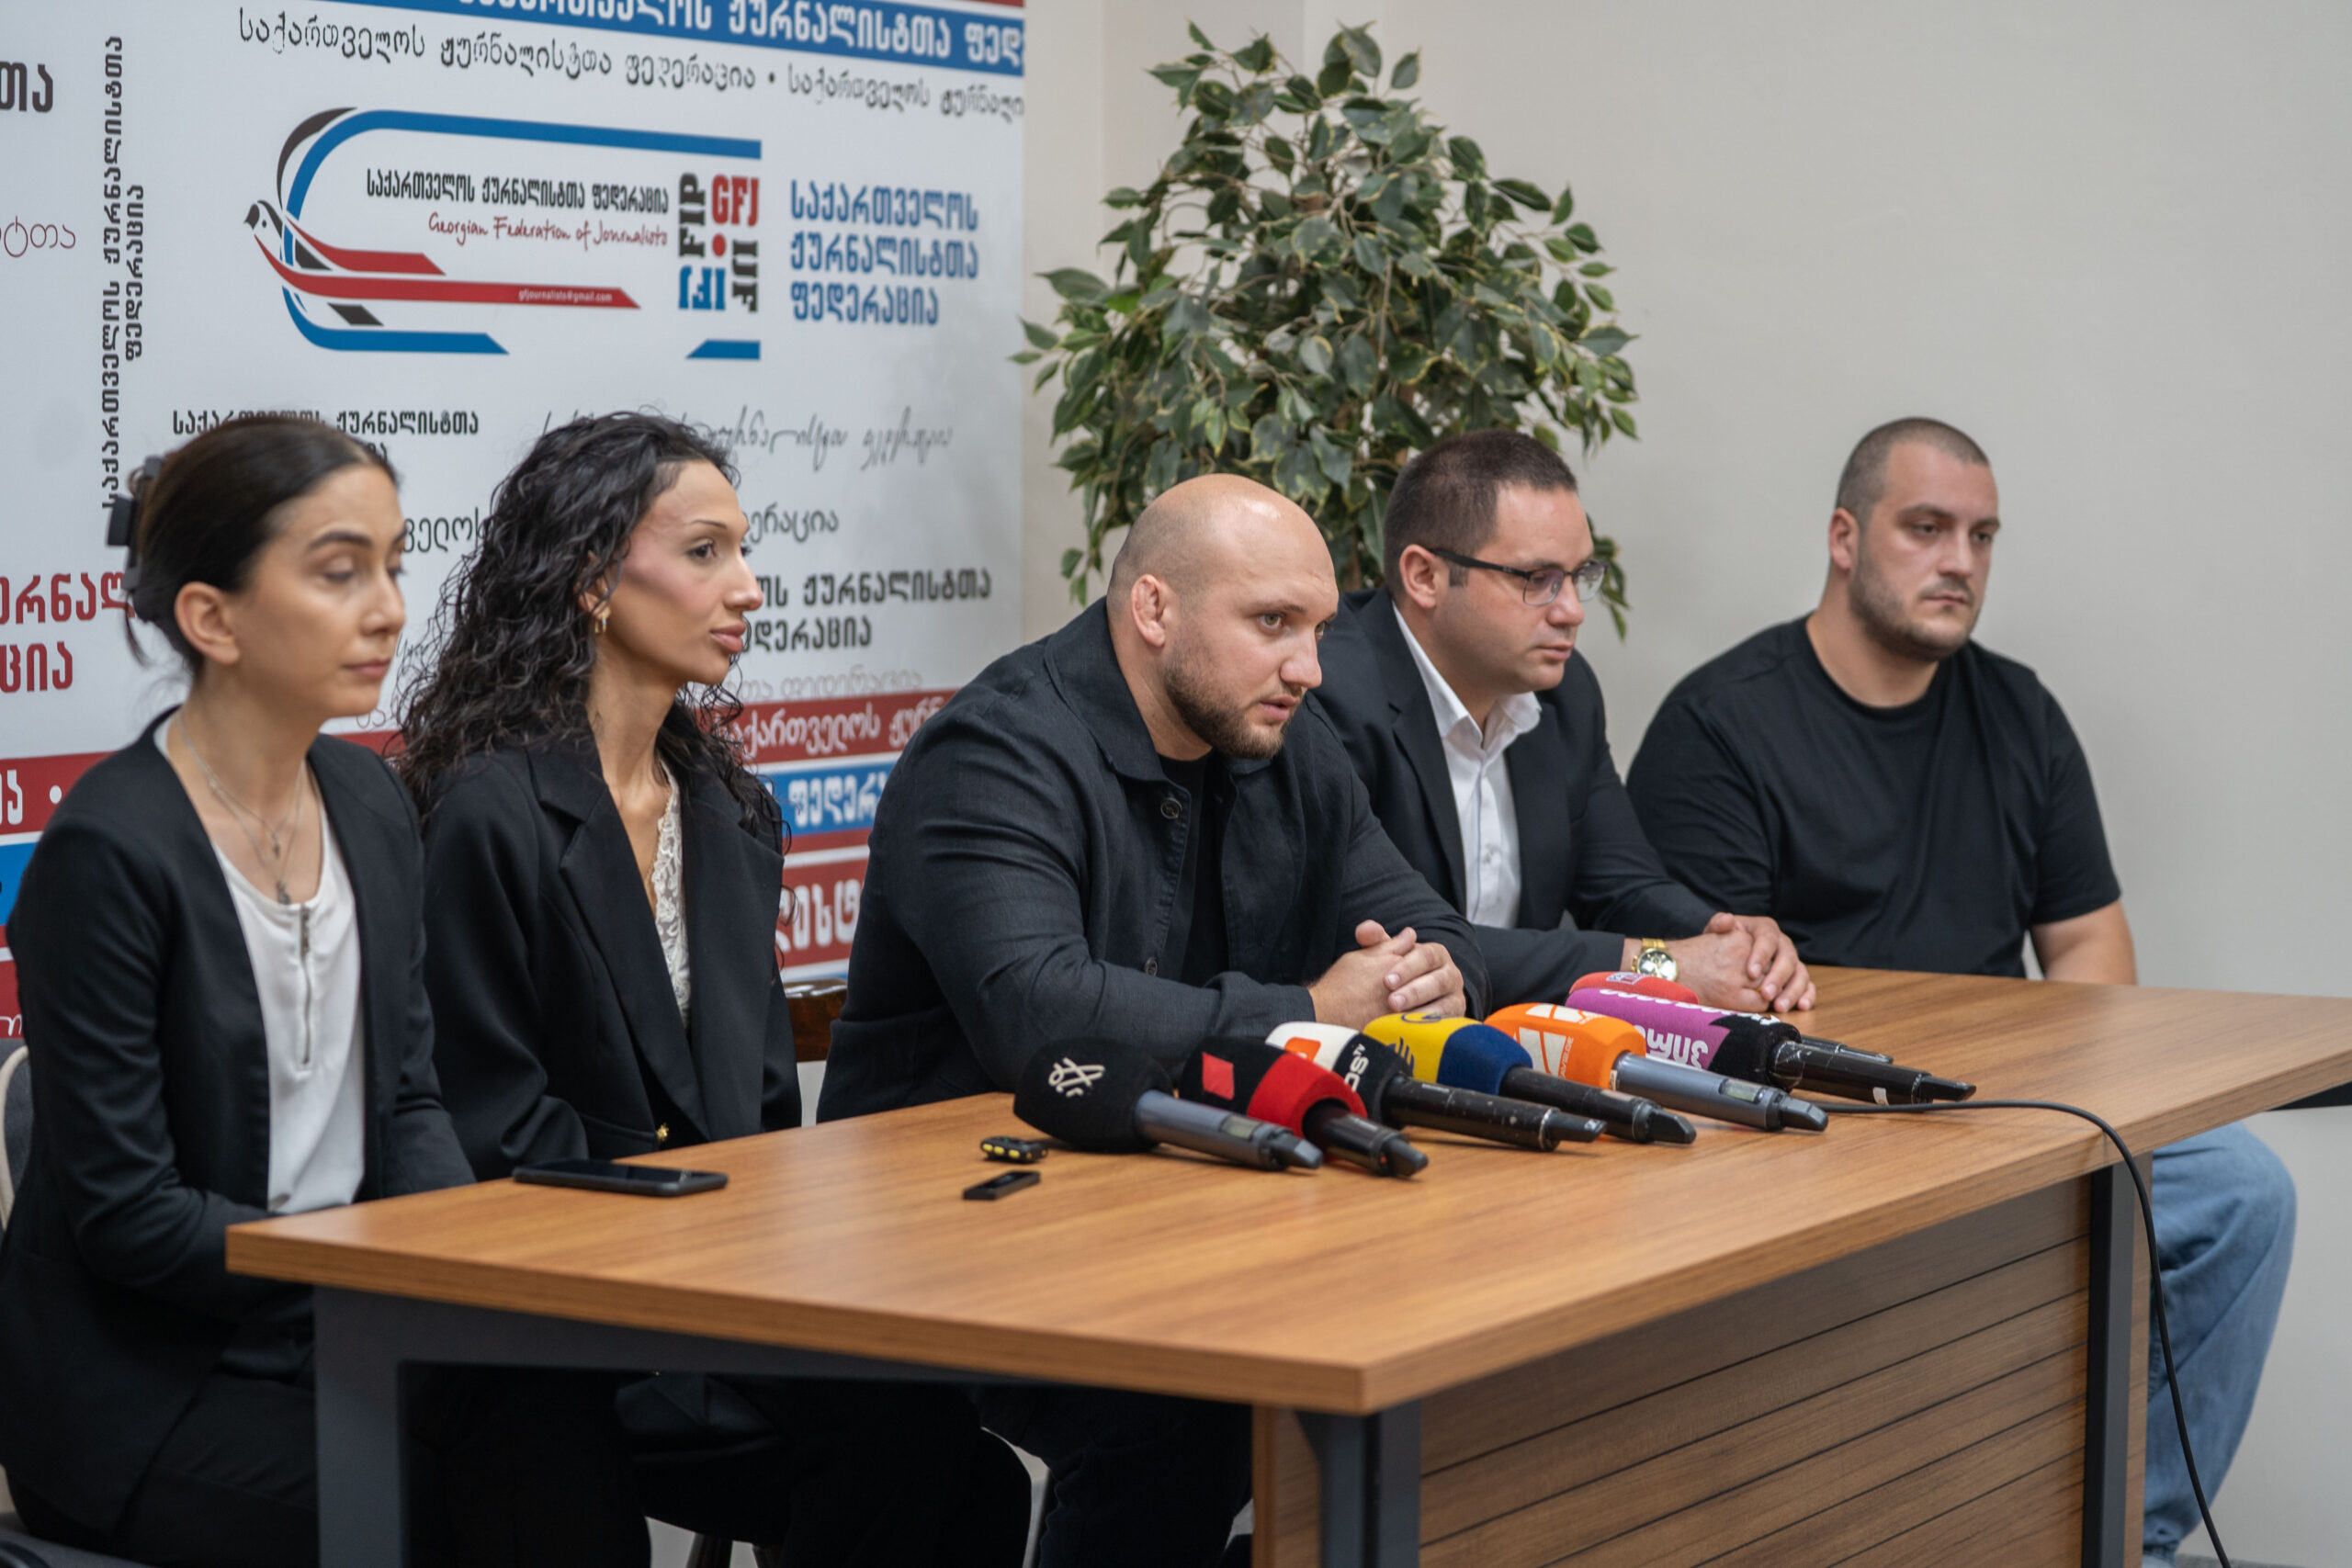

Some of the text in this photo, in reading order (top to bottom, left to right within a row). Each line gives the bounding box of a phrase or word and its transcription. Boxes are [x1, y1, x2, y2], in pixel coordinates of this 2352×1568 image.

[240, 7, 425, 63] საქართველოს
[440, 31, 612, 79] ჟურნალისტთა
[625, 52, 756, 91] ფედერაცია
[103, 36, 122, 265] ჟურნალისტთა
[368, 168, 669, 214] საქართველოს ჟურნალისტთა ფედერაცია
[711, 174, 760, 227] GFJ
[790, 179, 978, 231] საქართველოს
[428, 212, 669, 252] Georgian Federation of Journalists
[790, 231, 978, 280] ჟურნალისტთა
[125, 185, 143, 361] ფედერაცია
[790, 280, 940, 326] ფედერაცია
[803, 568, 991, 607] ჟურნალისტთა
